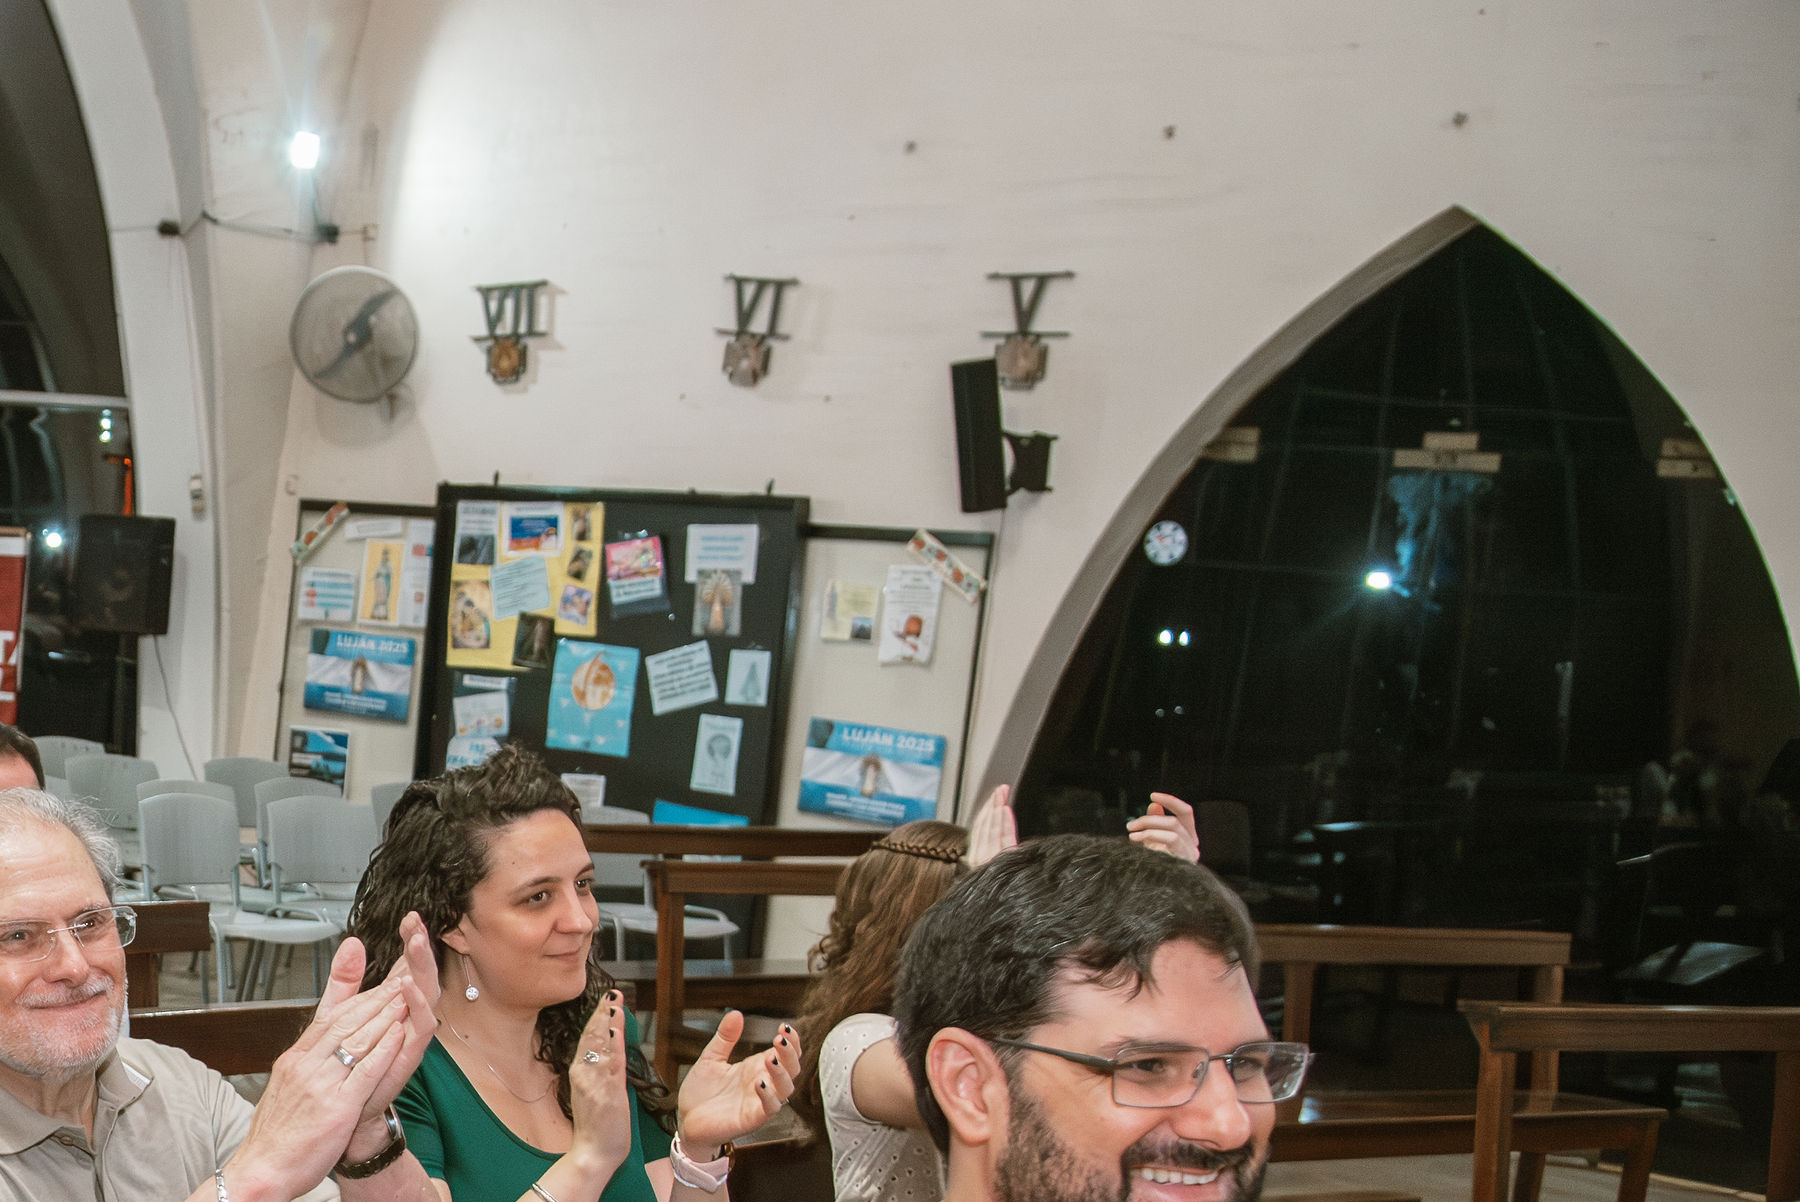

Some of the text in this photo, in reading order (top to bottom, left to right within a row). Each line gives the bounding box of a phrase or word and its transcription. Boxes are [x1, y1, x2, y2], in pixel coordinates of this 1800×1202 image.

[472, 279, 548, 341] VII
[715, 272, 800, 340] VI
[982, 270, 1076, 338] V
[842, 727, 935, 752] LUJÁN 2025
